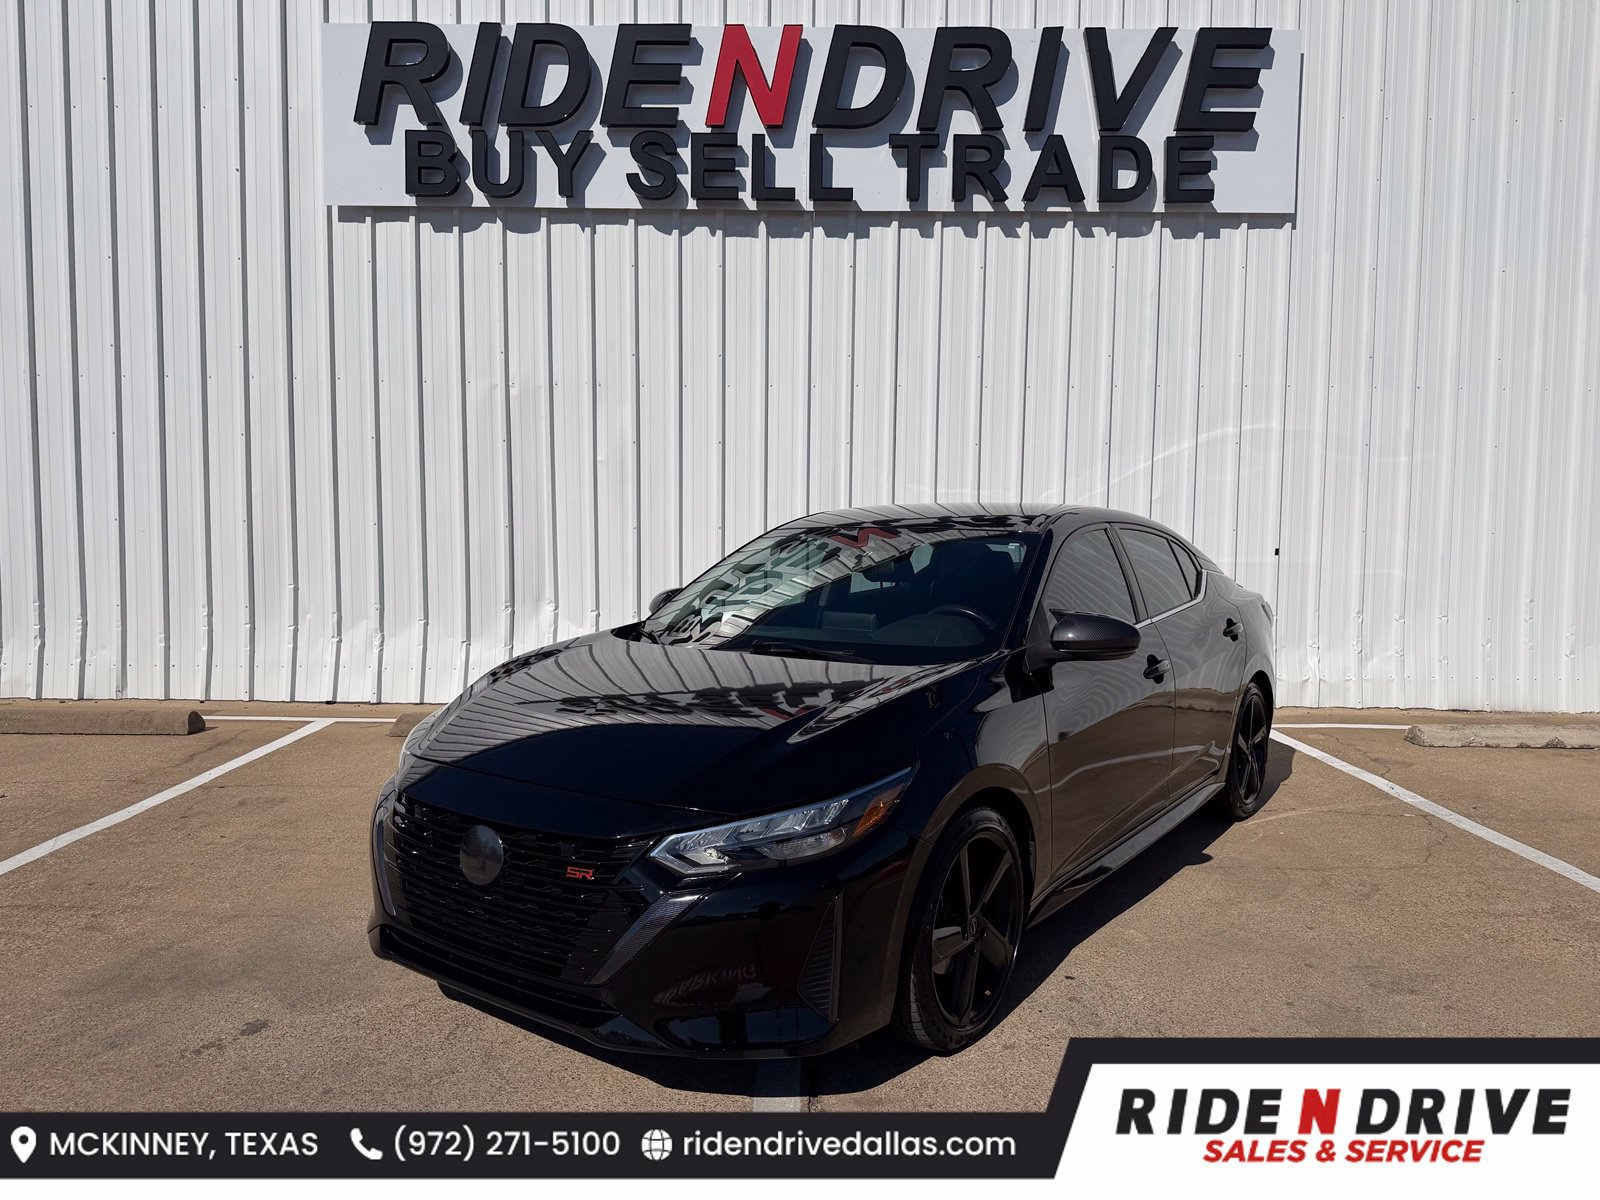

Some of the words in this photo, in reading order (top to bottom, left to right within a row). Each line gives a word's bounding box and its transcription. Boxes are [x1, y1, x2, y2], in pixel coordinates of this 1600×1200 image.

[405, 130, 594, 199] BUY
[626, 131, 854, 202] SELL
[889, 134, 1215, 203] TRADE
[566, 866, 593, 880] SR
